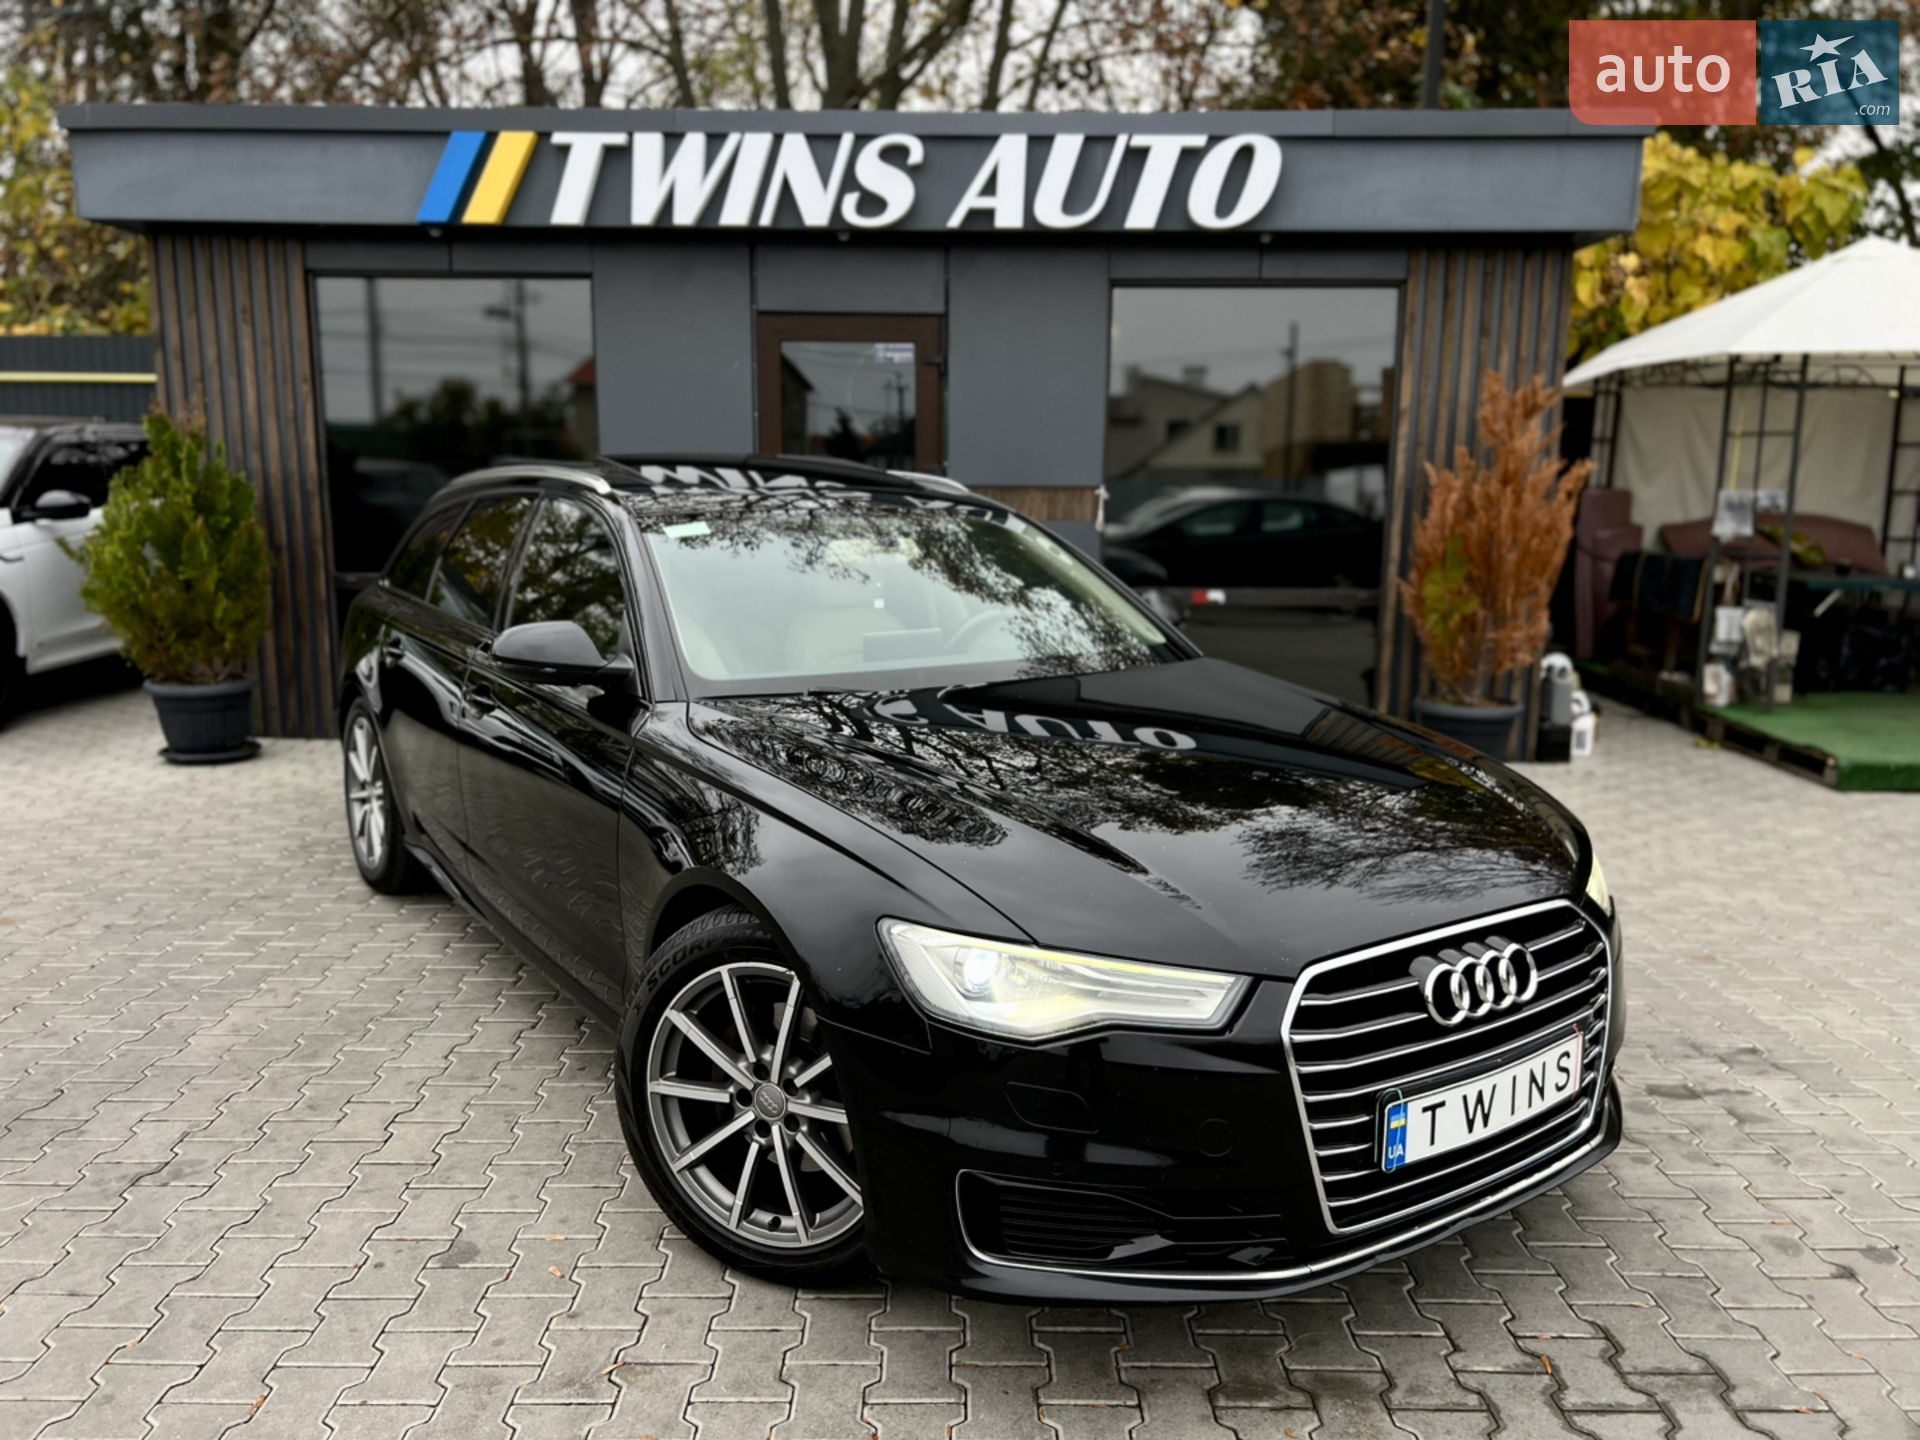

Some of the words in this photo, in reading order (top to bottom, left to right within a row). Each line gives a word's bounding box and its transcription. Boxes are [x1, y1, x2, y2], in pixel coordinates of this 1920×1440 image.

[549, 130, 925, 231] TWINS
[946, 131, 1284, 231] AUTO
[1421, 1050, 1572, 1147] TWINS
[1388, 1143, 1404, 1159] UA
